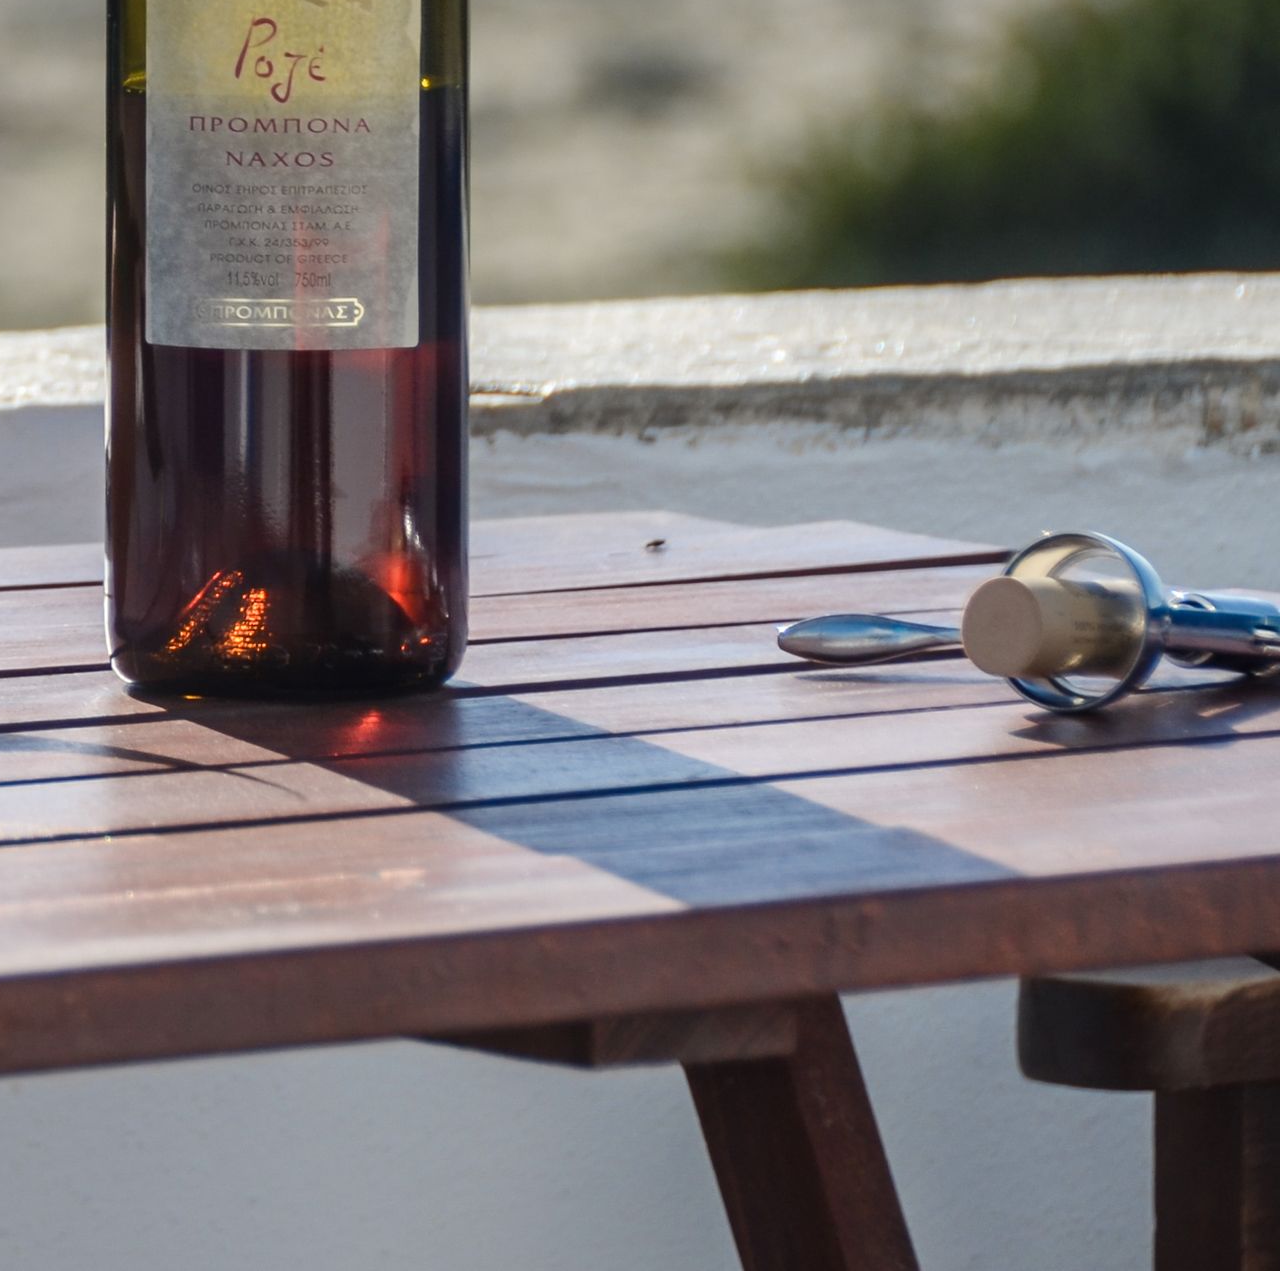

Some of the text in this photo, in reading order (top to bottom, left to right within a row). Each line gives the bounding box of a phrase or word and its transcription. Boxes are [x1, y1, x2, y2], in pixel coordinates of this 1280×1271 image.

[189, 115, 371, 134] ΠΡΟΜΠΟΝΑ
[225, 150, 335, 168] NAXOS
[191, 182, 231, 195] ΟΙΝΟΣ
[280, 184, 368, 196] ΕΠΙΤΡΑΠΕΖΙΟΣ
[197, 202, 263, 215] ΠΑΡΑΓΩΓΗ
[204, 219, 288, 232] ΠΡΟΜΠΟΝΑΣ
[209, 253, 349, 265] PRODUCT OF GREECE
